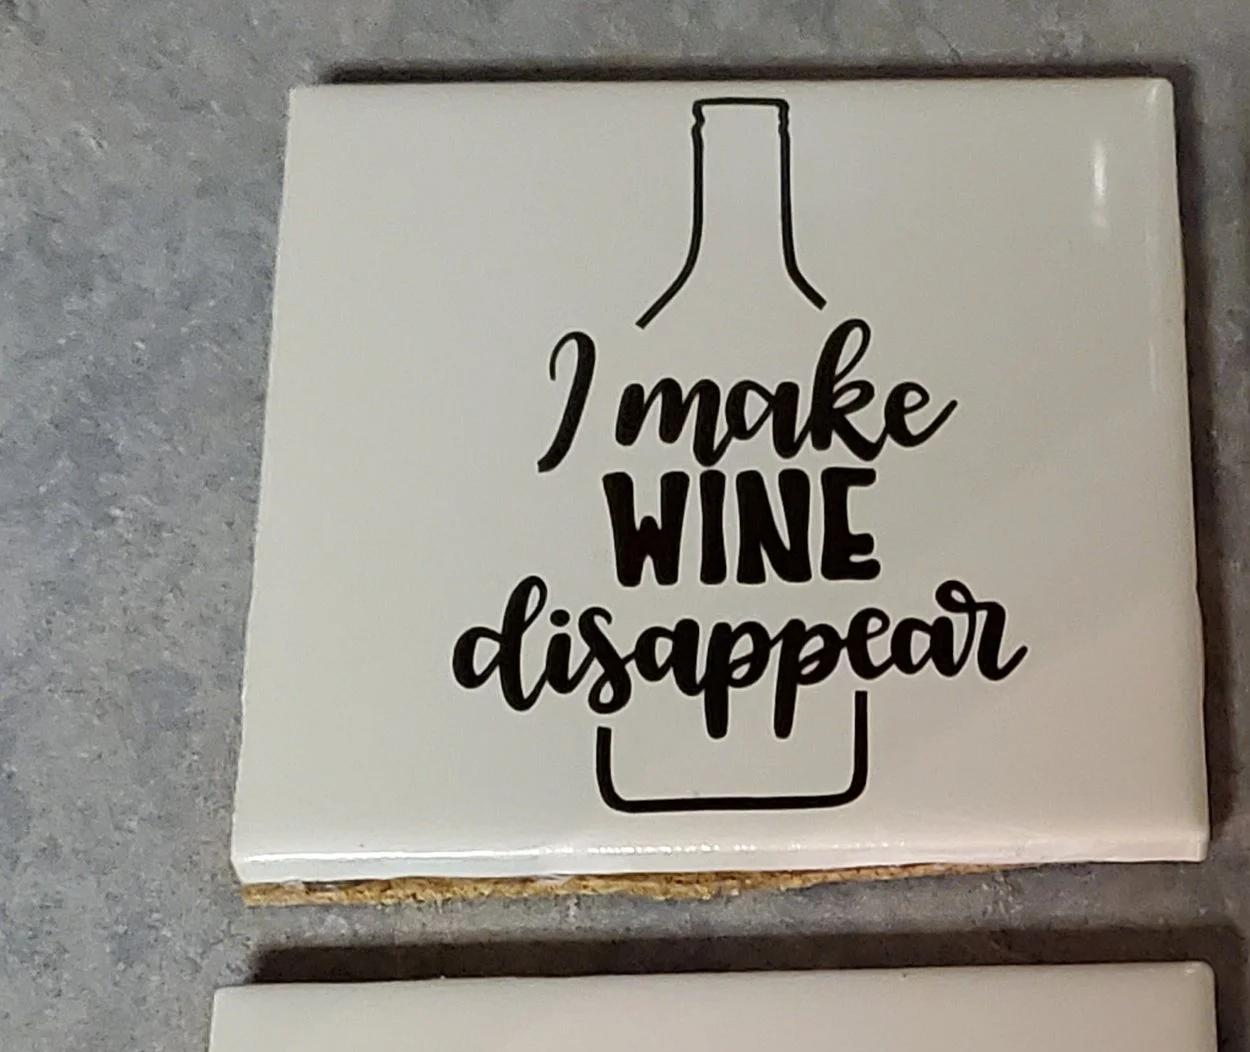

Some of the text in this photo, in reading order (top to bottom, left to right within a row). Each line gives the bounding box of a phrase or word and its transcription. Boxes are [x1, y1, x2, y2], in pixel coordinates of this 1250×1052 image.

[616, 319, 958, 467] make
[602, 466, 882, 588] WINE
[452, 575, 1028, 740] disappear
